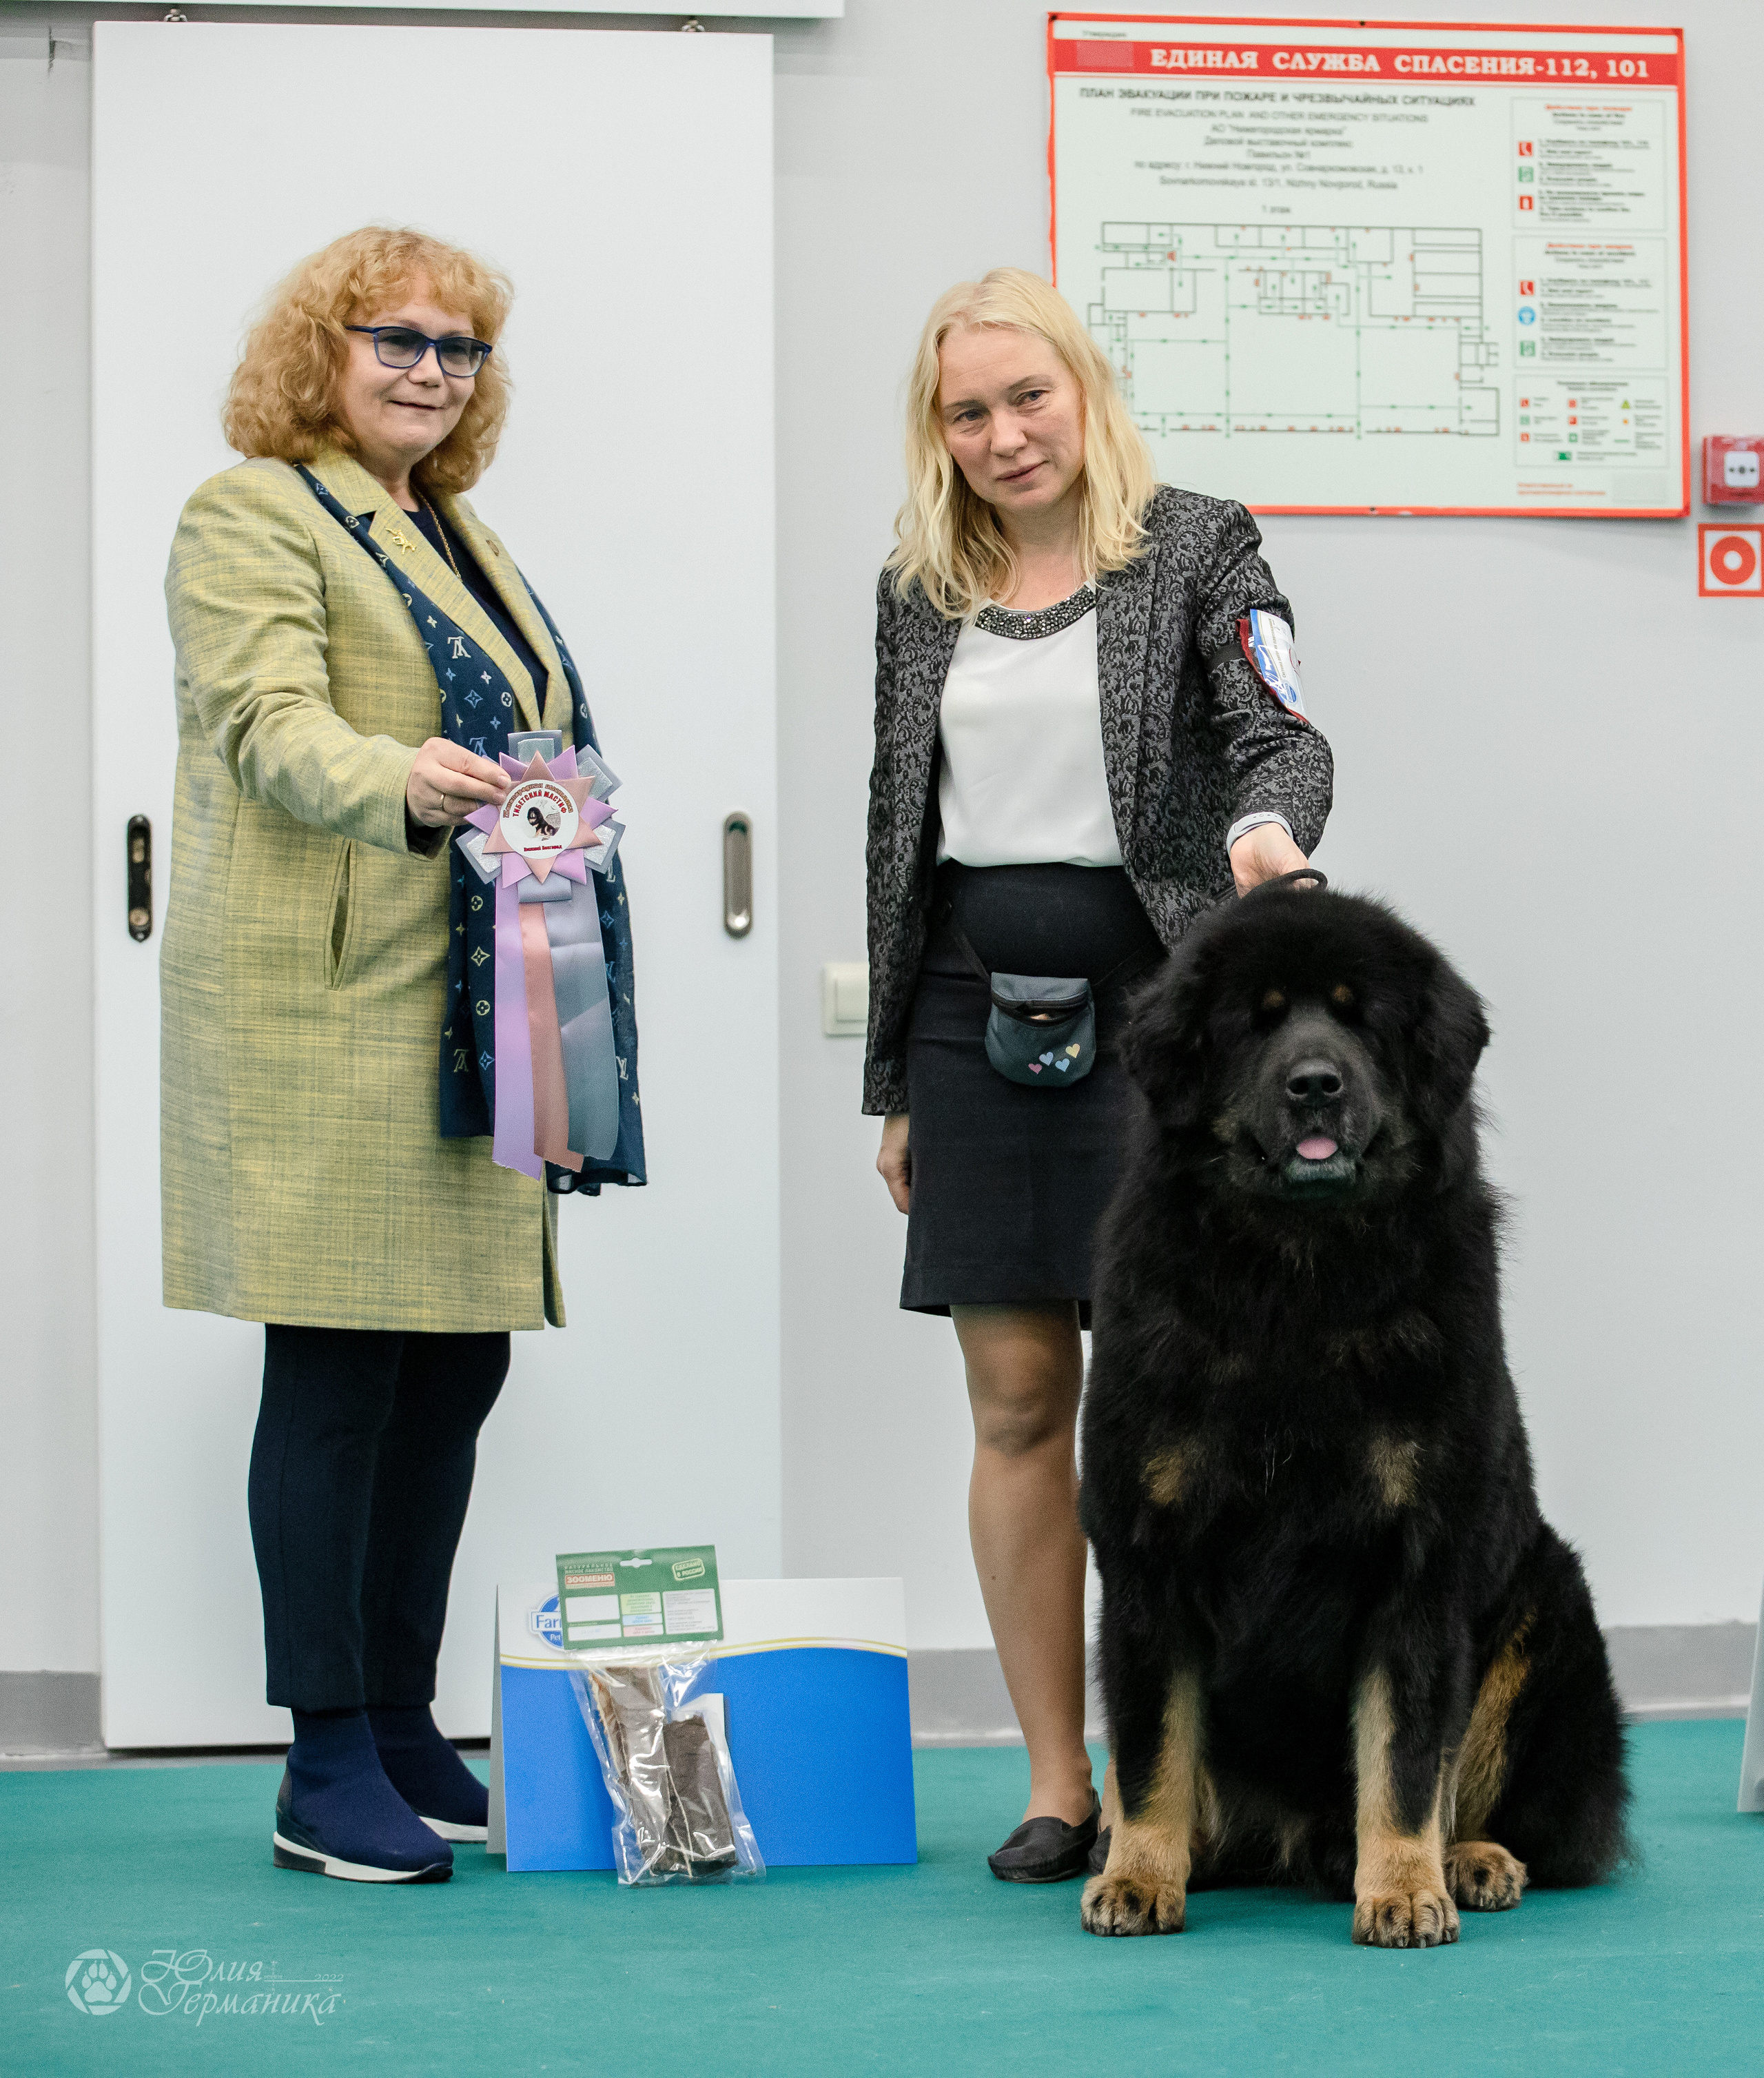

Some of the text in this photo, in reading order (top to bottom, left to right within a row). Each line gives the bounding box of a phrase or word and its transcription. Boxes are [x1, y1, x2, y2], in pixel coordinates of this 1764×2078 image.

[1151, 48, 1649, 79] ЕДИНАЯ СЛУЖБА СПАСЕНИЯ-112, 101
[1079, 88, 1476, 106] ПЛАН ЭВАКУАЦИИ ПРИ ПОЖАРЕ И ЧРЕЗВЫЧАЙНЫХ СИТУАЦИЯХ
[1130, 108, 1152, 116] FIRE
[1156, 108, 1216, 117] EVACUATION
[1219, 110, 1244, 119] PLAN
[1249, 110, 1269, 119] AND
[513, 789, 567, 817] ТИБЕТСКИЙ МАСТИФ
[675, 1560, 701, 1571] СДЕЛАНО
[681, 1567, 703, 1576] РОССИИ
[566, 1573, 613, 1584] ЗООМЕНЮ
